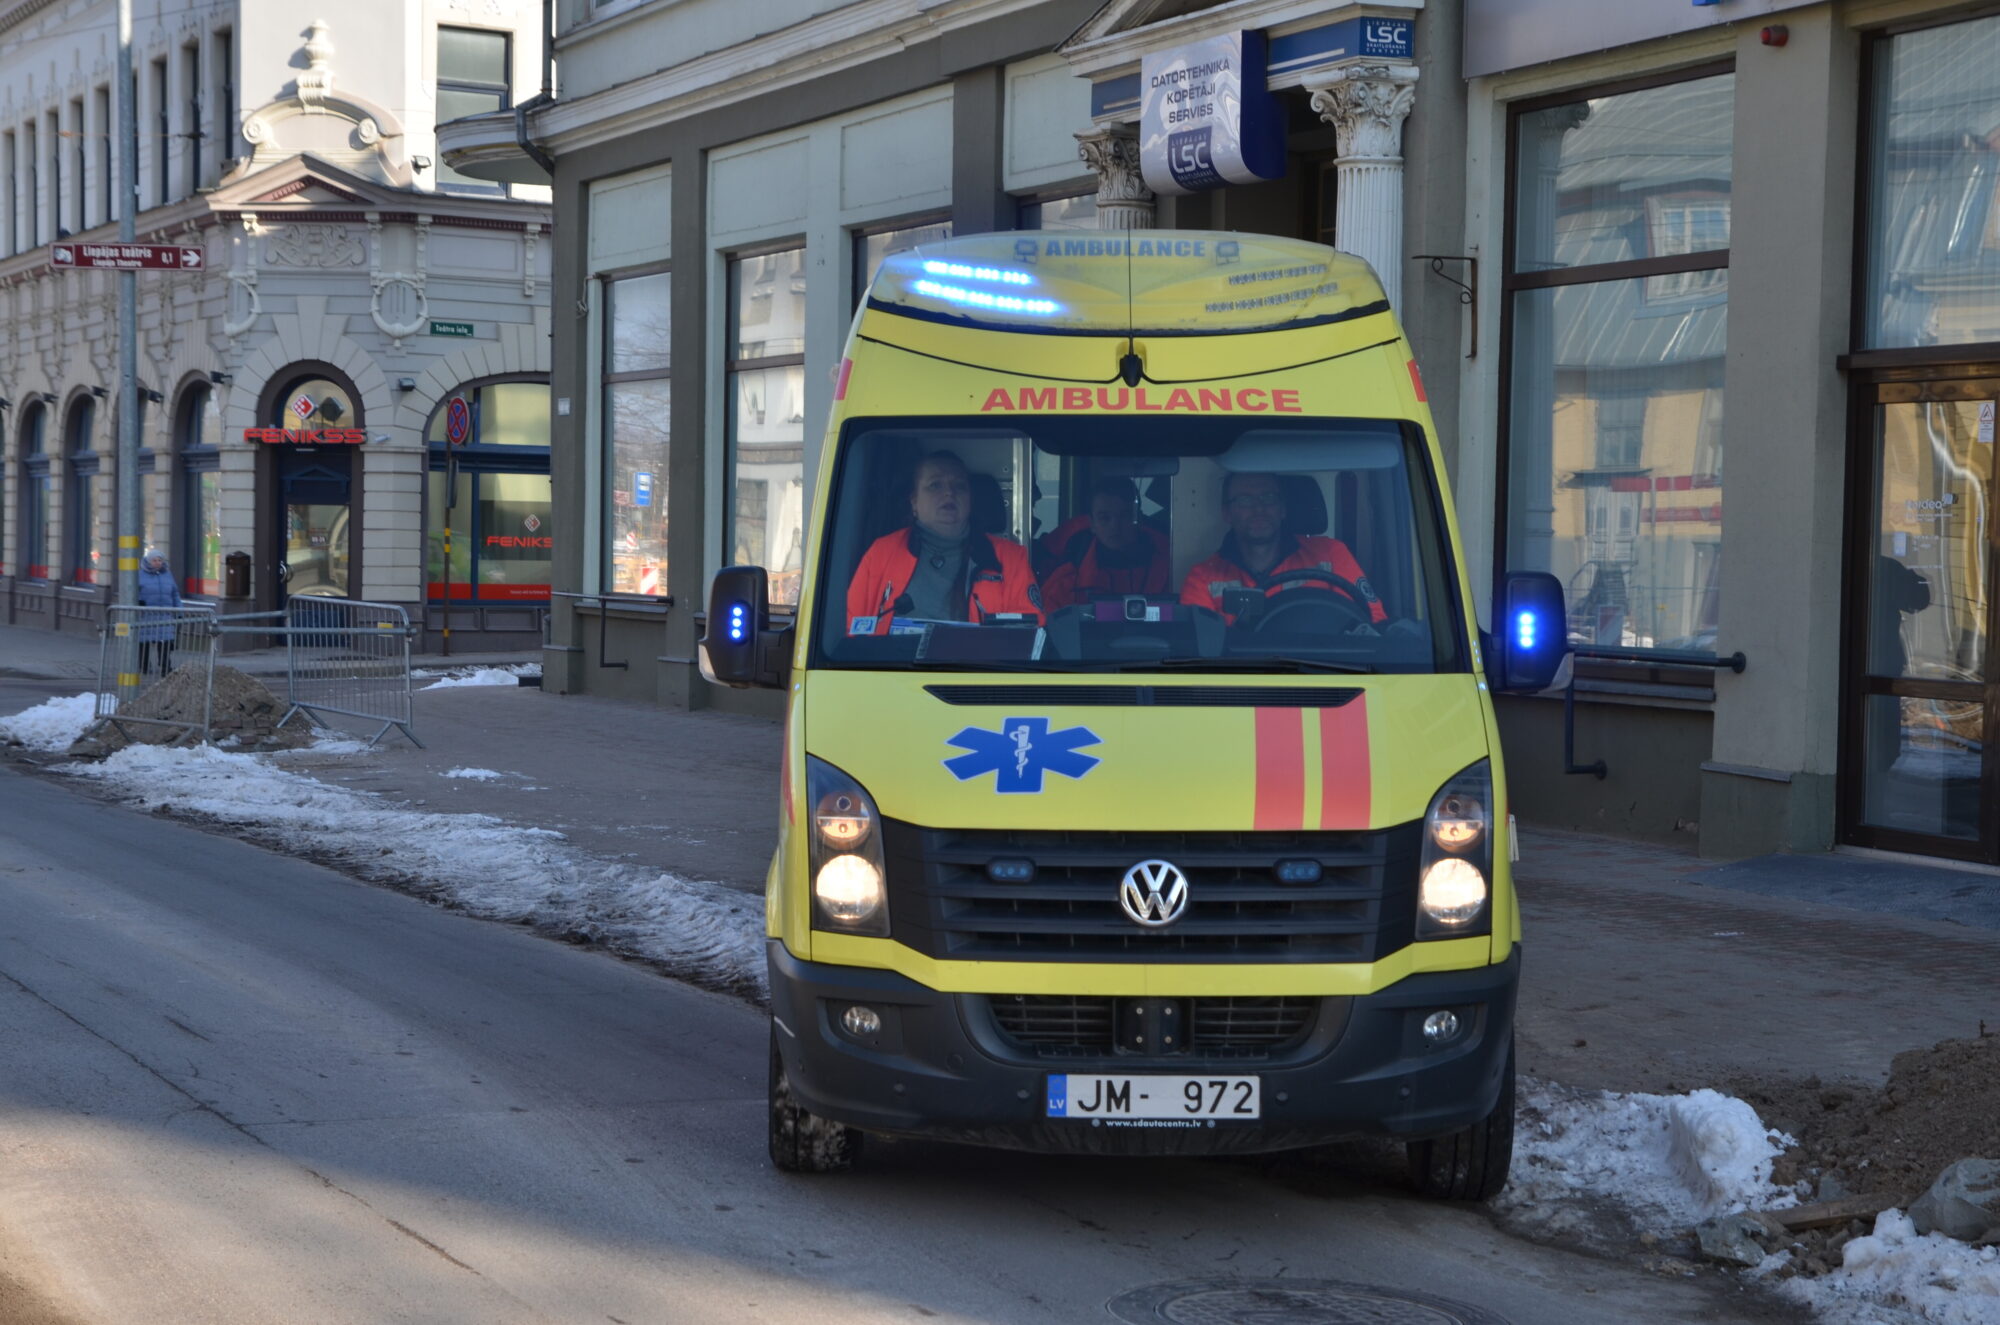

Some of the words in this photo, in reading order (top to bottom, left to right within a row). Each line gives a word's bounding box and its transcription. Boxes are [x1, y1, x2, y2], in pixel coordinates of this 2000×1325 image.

[1366, 25, 1407, 45] LSC
[1151, 58, 1231, 89] DATORTEHNIKA
[1166, 80, 1216, 106] KOPĒTĀJI
[1168, 102, 1214, 124] SERVISS
[1171, 141, 1210, 174] LSC
[1045, 239, 1206, 258] AMBULANCE
[980, 387, 1303, 413] AMBULANCE
[243, 427, 366, 444] FENIKSS
[485, 535, 553, 548] FENIKS
[1049, 1099, 1065, 1109] LV
[1183, 1080, 1253, 1114] 972
[1105, 1118, 1202, 1129] www.sdautocentrs.lv
